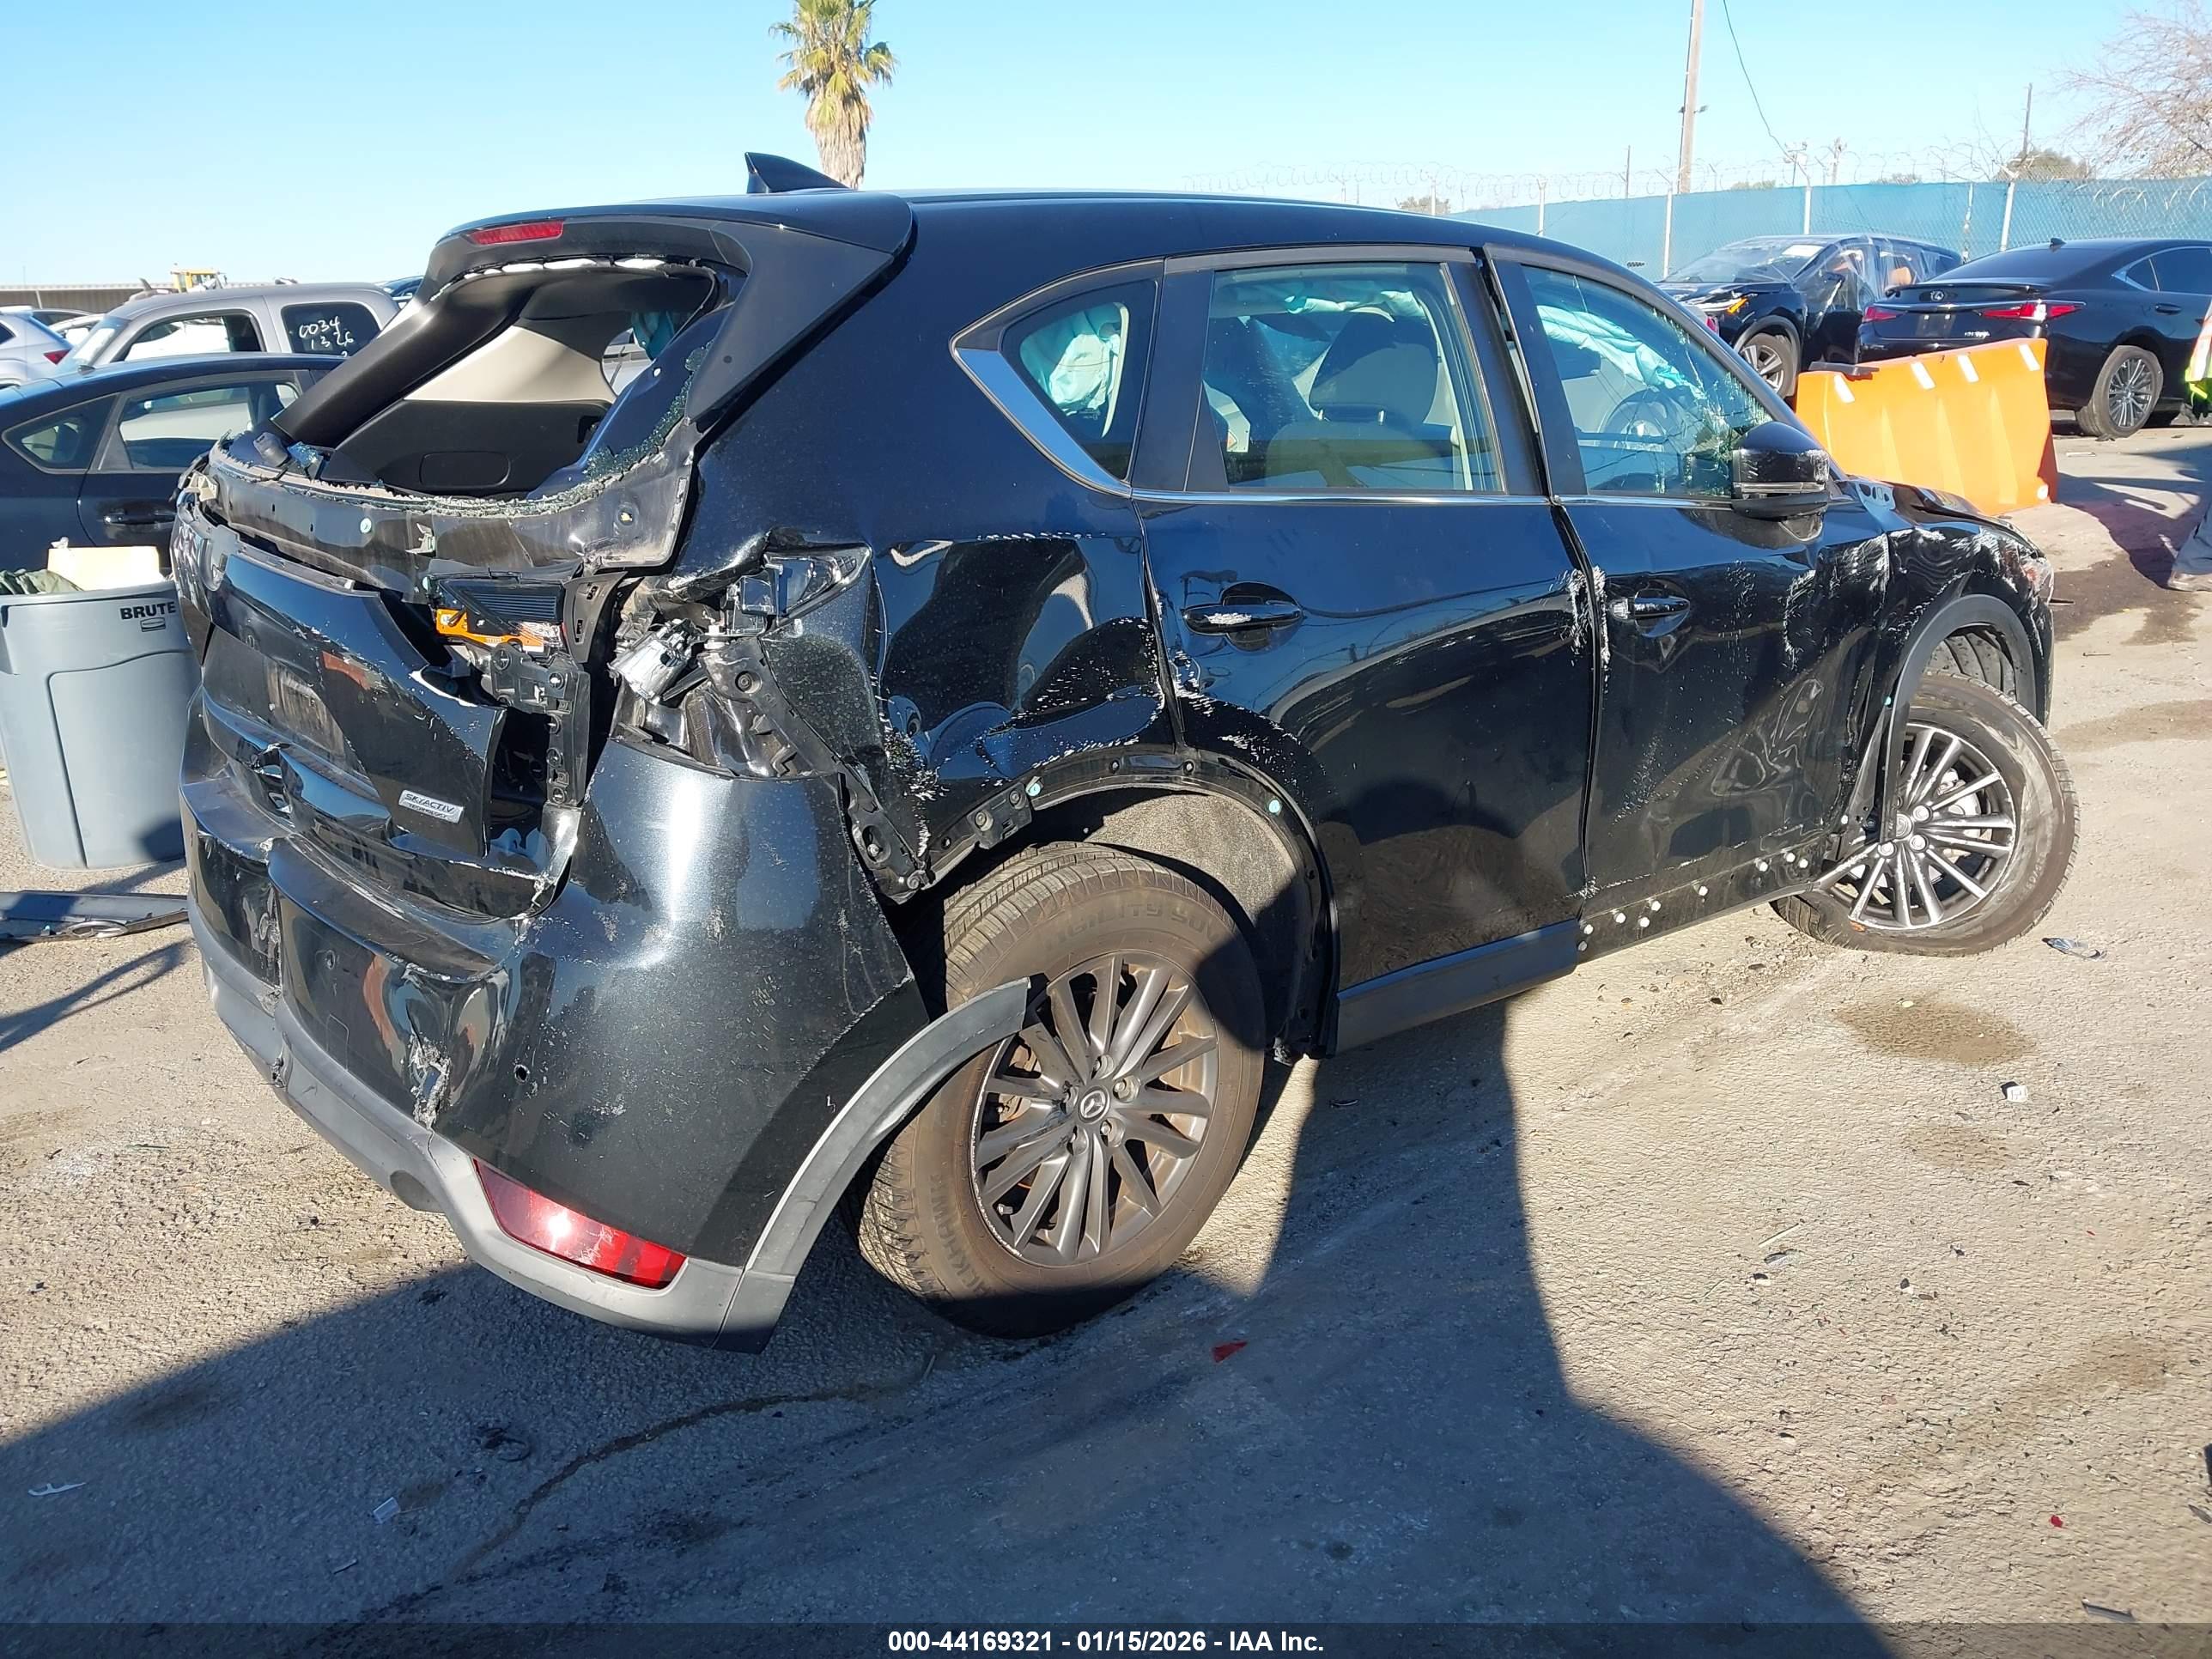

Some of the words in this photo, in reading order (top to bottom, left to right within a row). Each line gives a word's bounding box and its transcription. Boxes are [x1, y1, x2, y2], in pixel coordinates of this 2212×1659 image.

[299, 315, 341, 338] 0034
[119, 601, 177, 620] BRUTE
[404, 793, 455, 813] SKYACTIV
